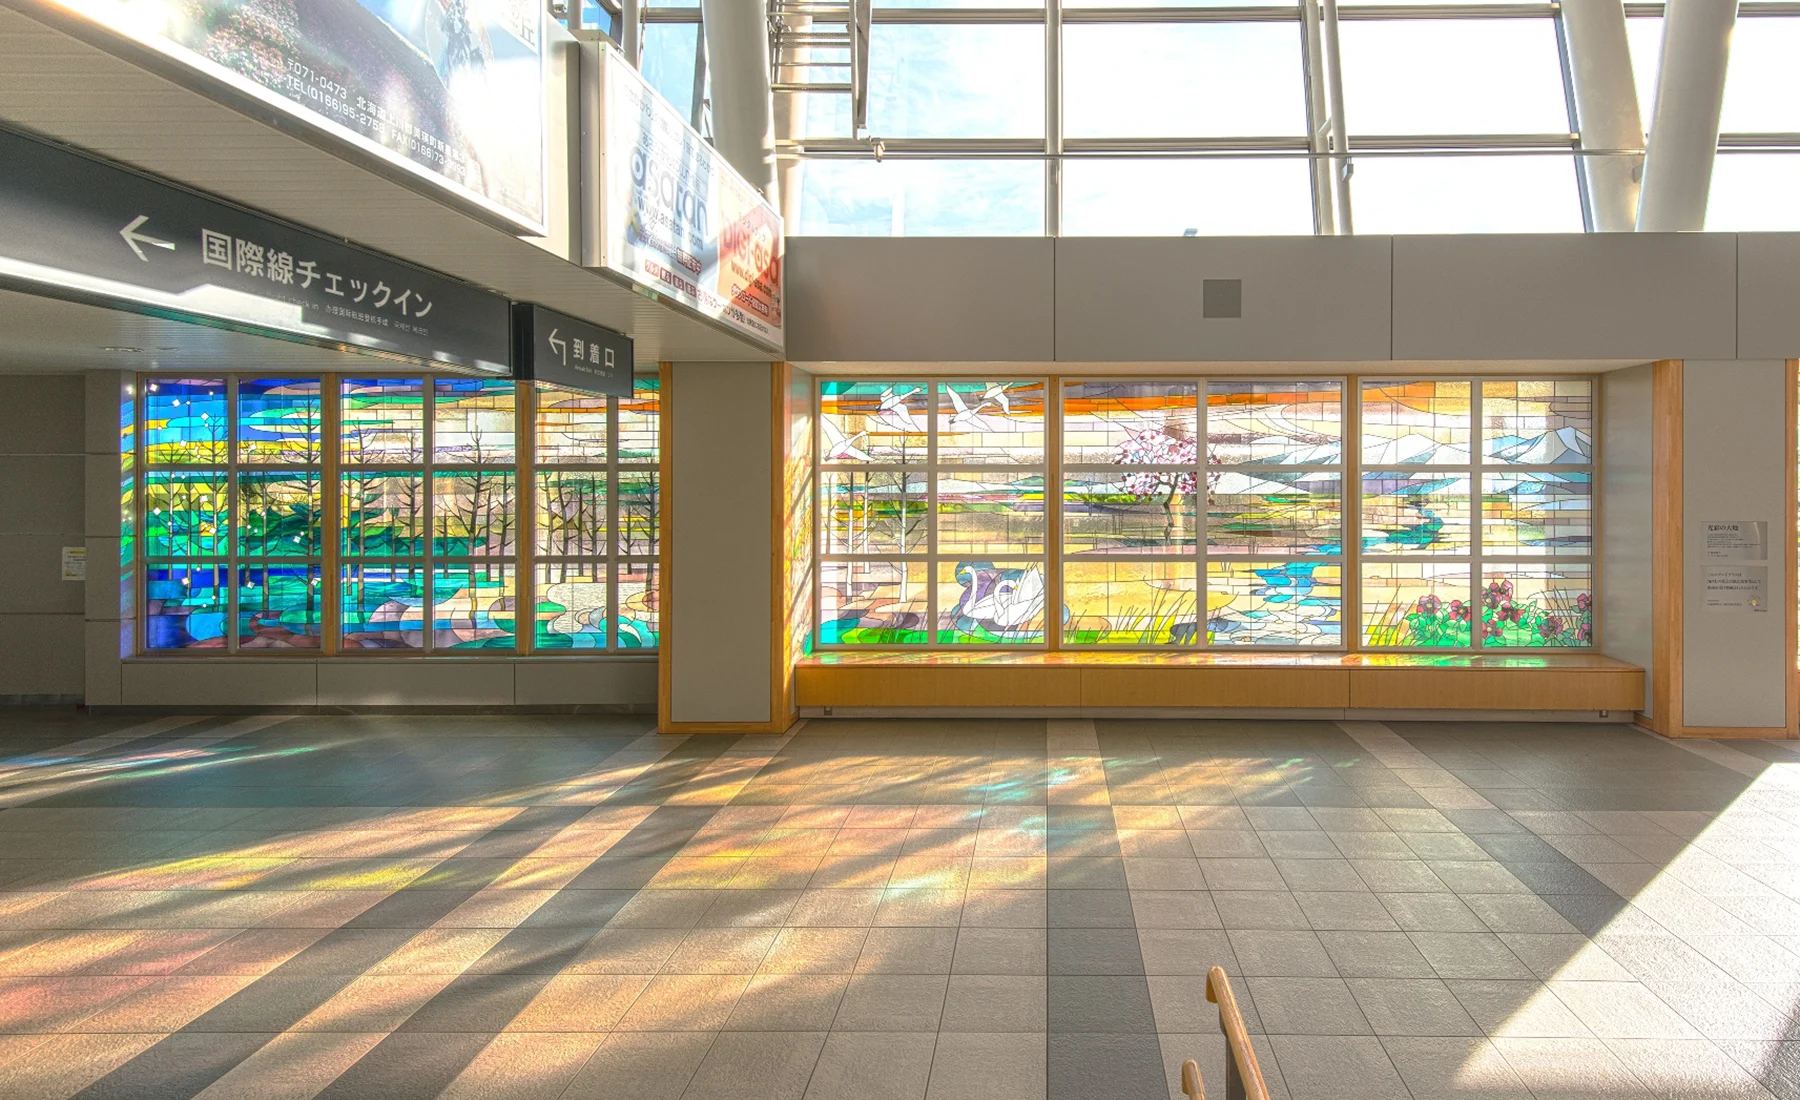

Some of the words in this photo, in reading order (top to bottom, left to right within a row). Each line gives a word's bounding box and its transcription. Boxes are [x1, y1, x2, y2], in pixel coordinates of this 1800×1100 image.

[637, 196, 704, 251] www.asatancom
[202, 228, 433, 318] 国際線チェックイン
[573, 338, 615, 369] 到着口
